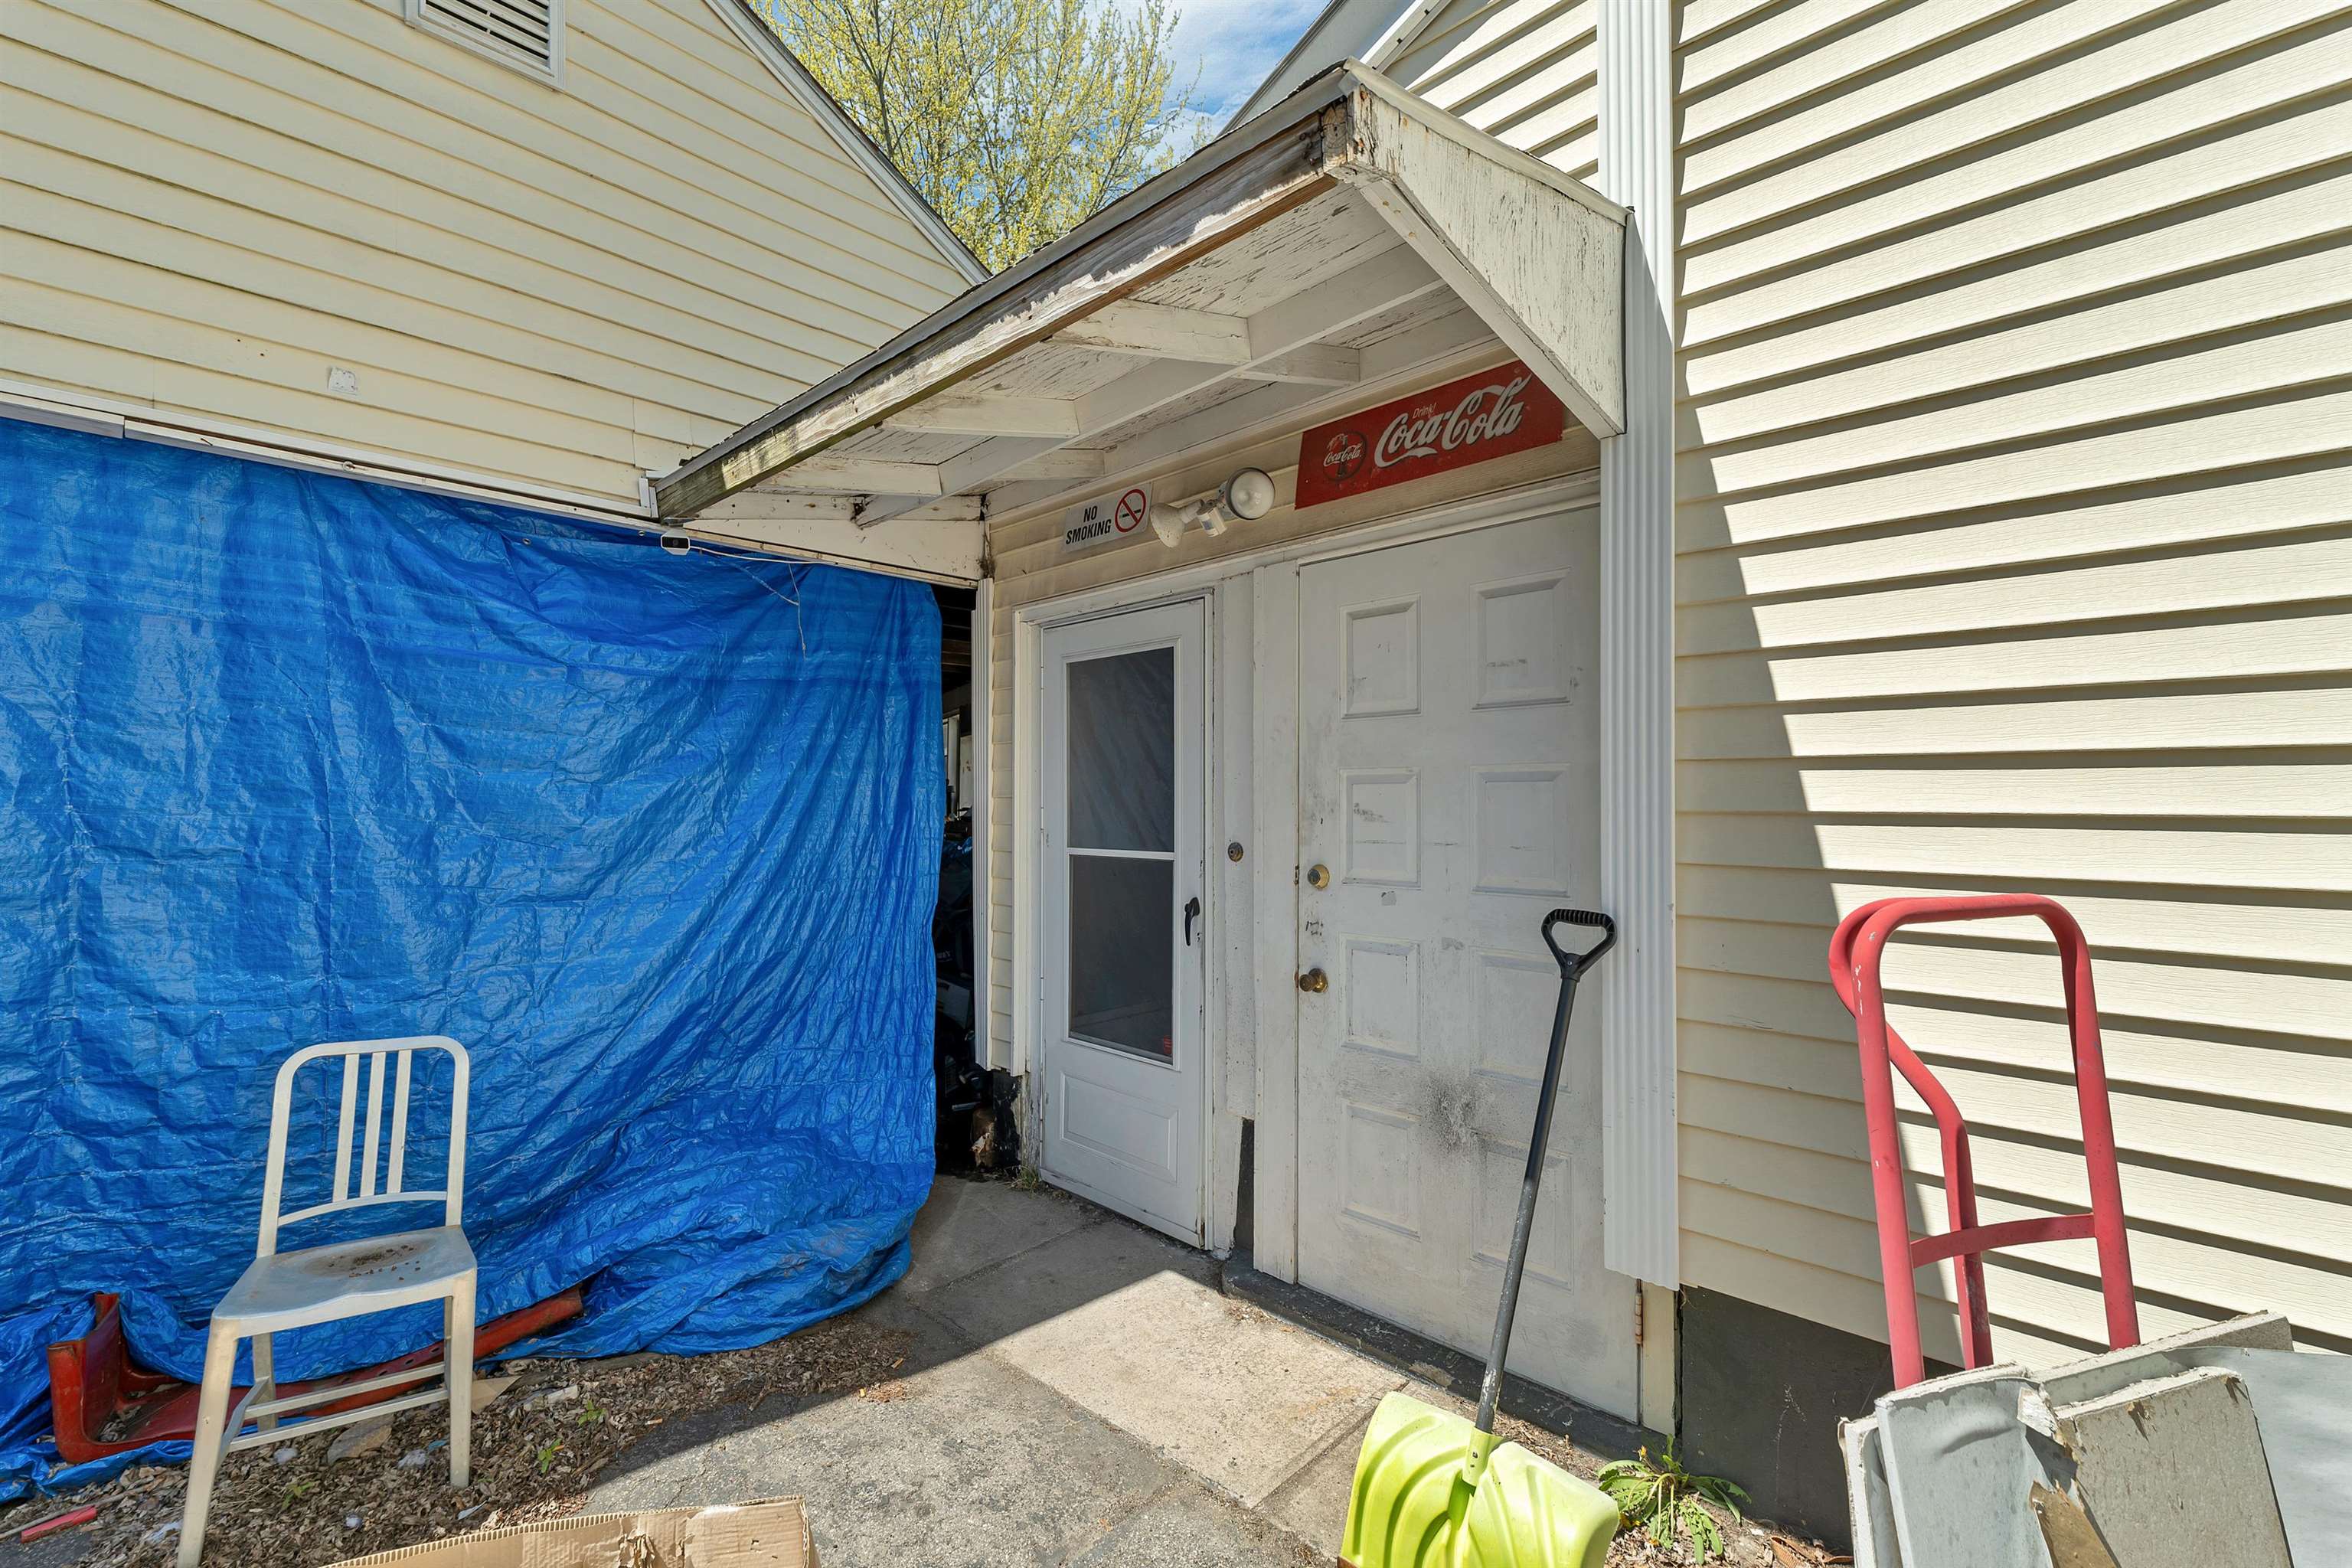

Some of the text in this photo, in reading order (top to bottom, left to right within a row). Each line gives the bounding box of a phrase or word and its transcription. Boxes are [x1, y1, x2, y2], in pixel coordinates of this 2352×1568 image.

[1374, 373, 1531, 468] Coca-Cola
[1083, 505, 1098, 522] NO
[1066, 519, 1112, 544] SMOKING
